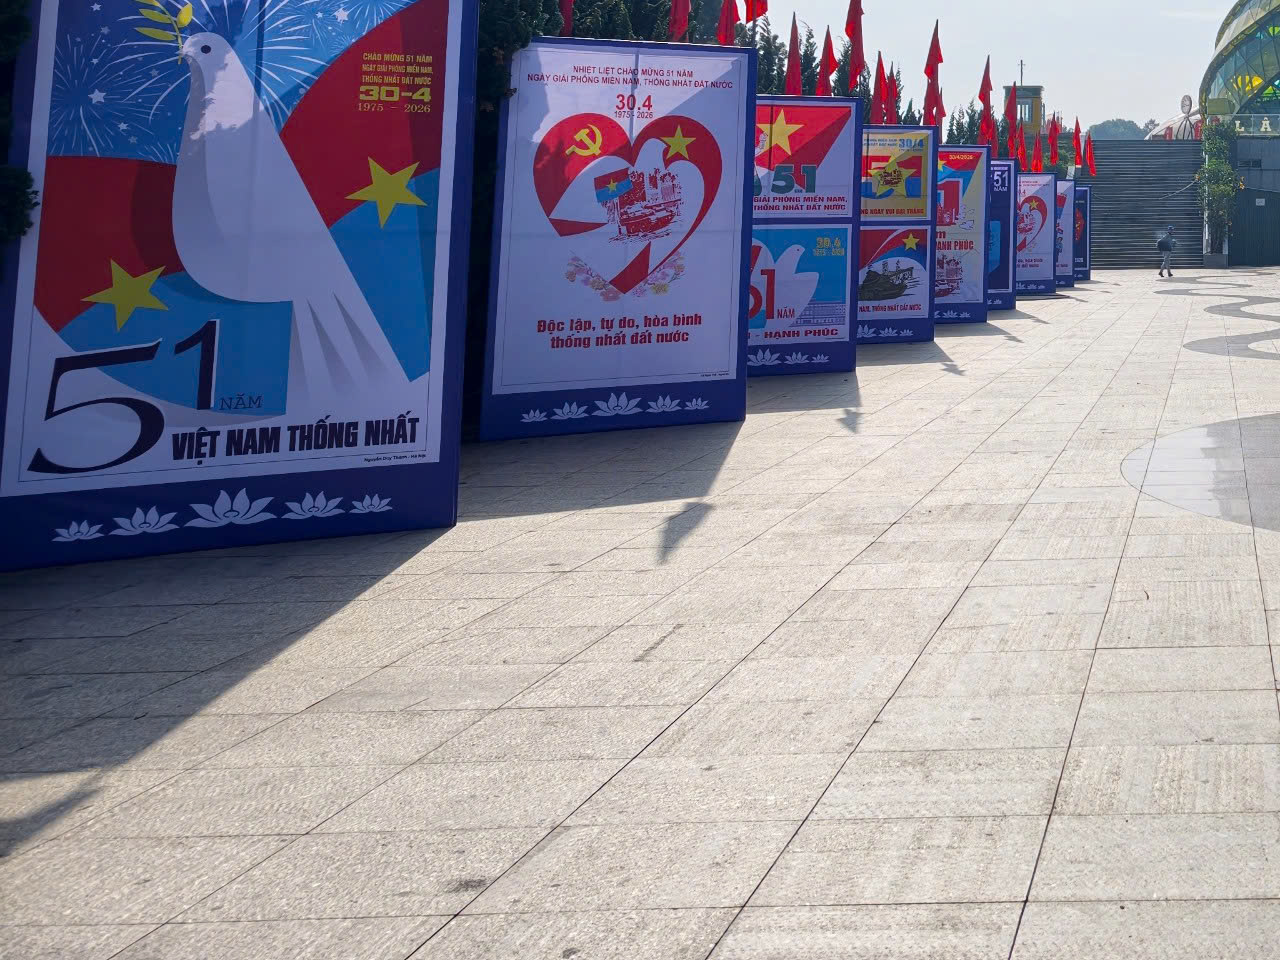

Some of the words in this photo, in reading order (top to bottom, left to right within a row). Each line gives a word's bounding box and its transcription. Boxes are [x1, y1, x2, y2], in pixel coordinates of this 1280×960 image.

[363, 52, 381, 60] CHÀO
[384, 52, 404, 62] MỪNG
[416, 54, 433, 63] NĂM
[527, 72, 551, 81] NGÀY
[553, 74, 569, 82] GIẢI
[571, 74, 599, 83] PHÓNG
[601, 76, 620, 84] MIỀN
[622, 78, 641, 86] NAM,
[644, 78, 670, 87] THỐNG
[672, 79, 692, 87] NHẤT
[694, 79, 709, 88] ĐẤT
[710, 81, 733, 89] NƯỚC
[573, 66, 596, 74] NHIỆT
[598, 67, 615, 76] LIỆT
[617, 67, 638, 75] CHÀO
[641, 67, 664, 76] MỪNG
[677, 70, 693, 78] NĂM
[360, 85, 431, 102] 30-4
[358, 103, 383, 112] 1975
[404, 104, 431, 113] 2026
[615, 94, 653, 111] 30.4
[637, 111, 653, 119] 2026
[771, 164, 817, 194] 51
[994, 171, 1008, 187] 51
[954, 239, 974, 250] PHÚC
[777, 307, 795, 318] NĂM
[537, 319, 565, 334] Độc
[569, 318, 596, 333] lập,
[600, 317, 615, 331] tự
[619, 316, 640, 330] do,
[643, 315, 669, 328] hòa
[673, 313, 702, 327] bình
[551, 333, 591, 349] thống
[595, 331, 627, 346] nhất
[630, 330, 652, 344] đất
[656, 330, 689, 343] nước
[764, 330, 800, 339] HẠNH
[804, 328, 838, 337] PHÚC
[27, 319, 219, 474] 51
[219, 393, 263, 410] NĂM
[172, 426, 220, 465] VIỆT
[226, 427, 281, 457] NAM
[287, 415, 359, 451] THỐNG
[364, 410, 420, 446] NHẤT
